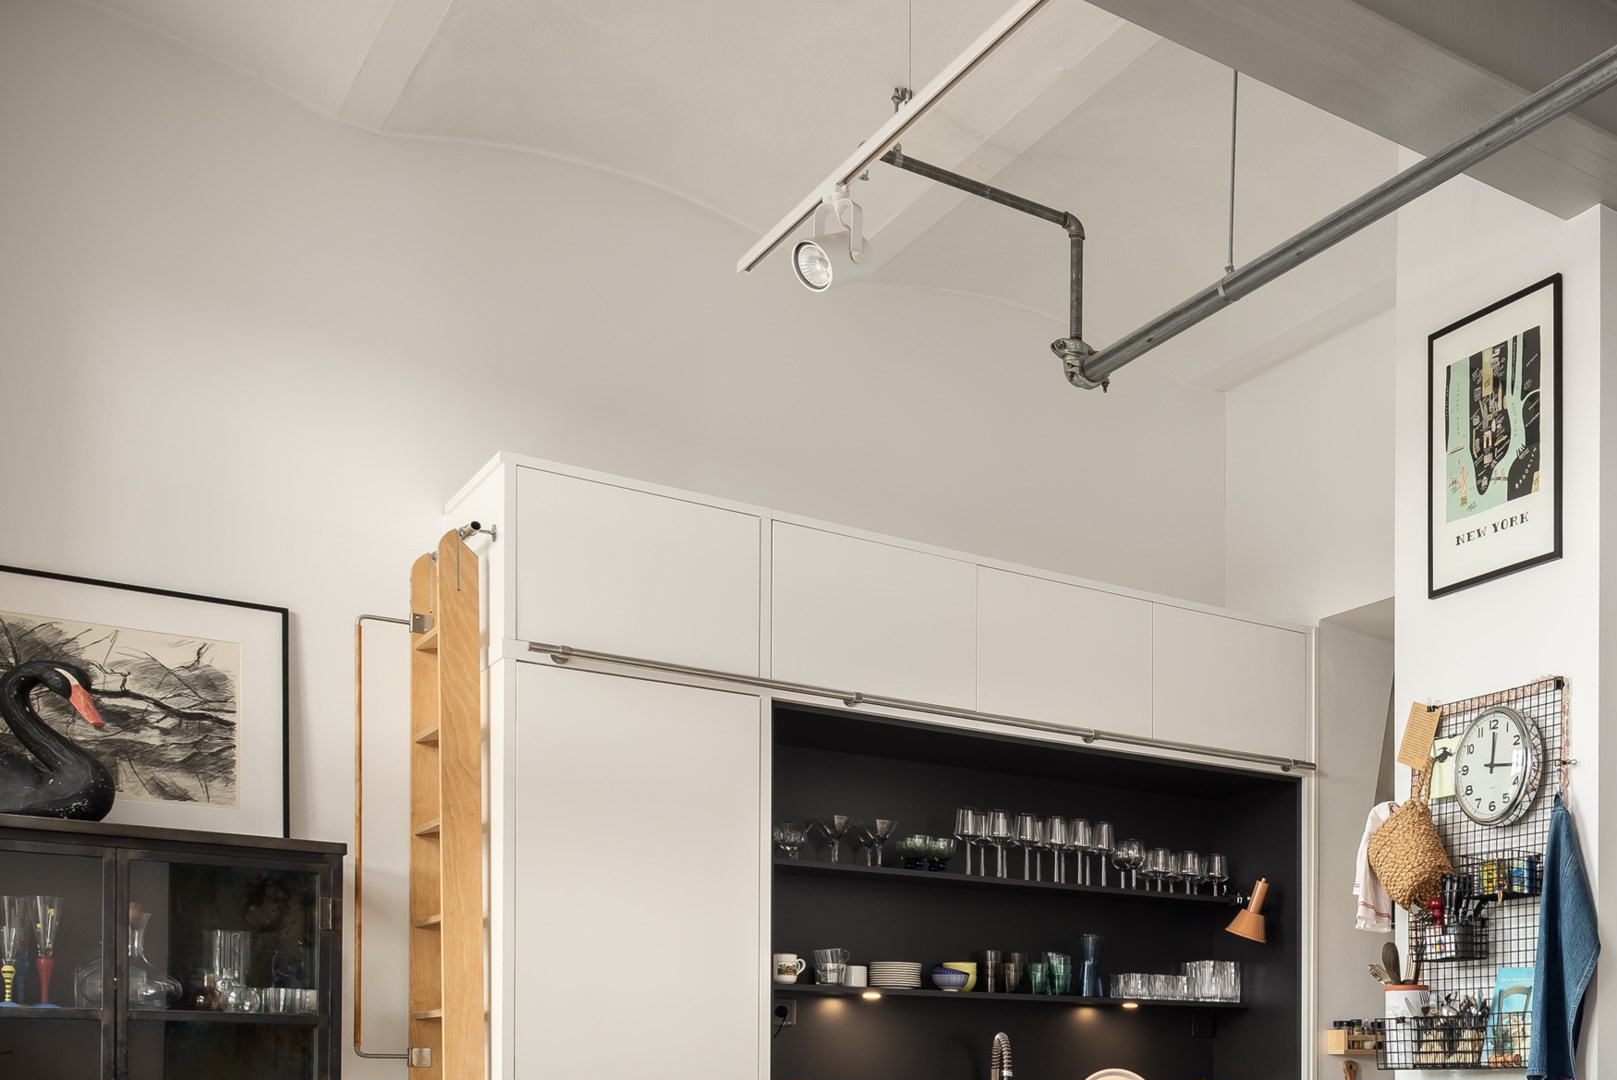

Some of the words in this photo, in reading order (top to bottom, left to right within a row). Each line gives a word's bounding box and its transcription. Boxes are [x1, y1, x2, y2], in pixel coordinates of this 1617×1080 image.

[1456, 526, 1487, 546] NEW
[1492, 511, 1529, 533] YORK
[1489, 719, 1499, 731] 12
[1505, 721, 1509, 733] 1
[1477, 727, 1484, 738] 11
[1512, 734, 1521, 746] 2
[1466, 744, 1475, 755] 10
[1461, 765, 1469, 776] 9
[1512, 775, 1519, 786] 4
[1465, 785, 1473, 796] 8
[1475, 797, 1482, 809] 7
[1502, 793, 1510, 804] 5
[1488, 801, 1496, 812] 6
